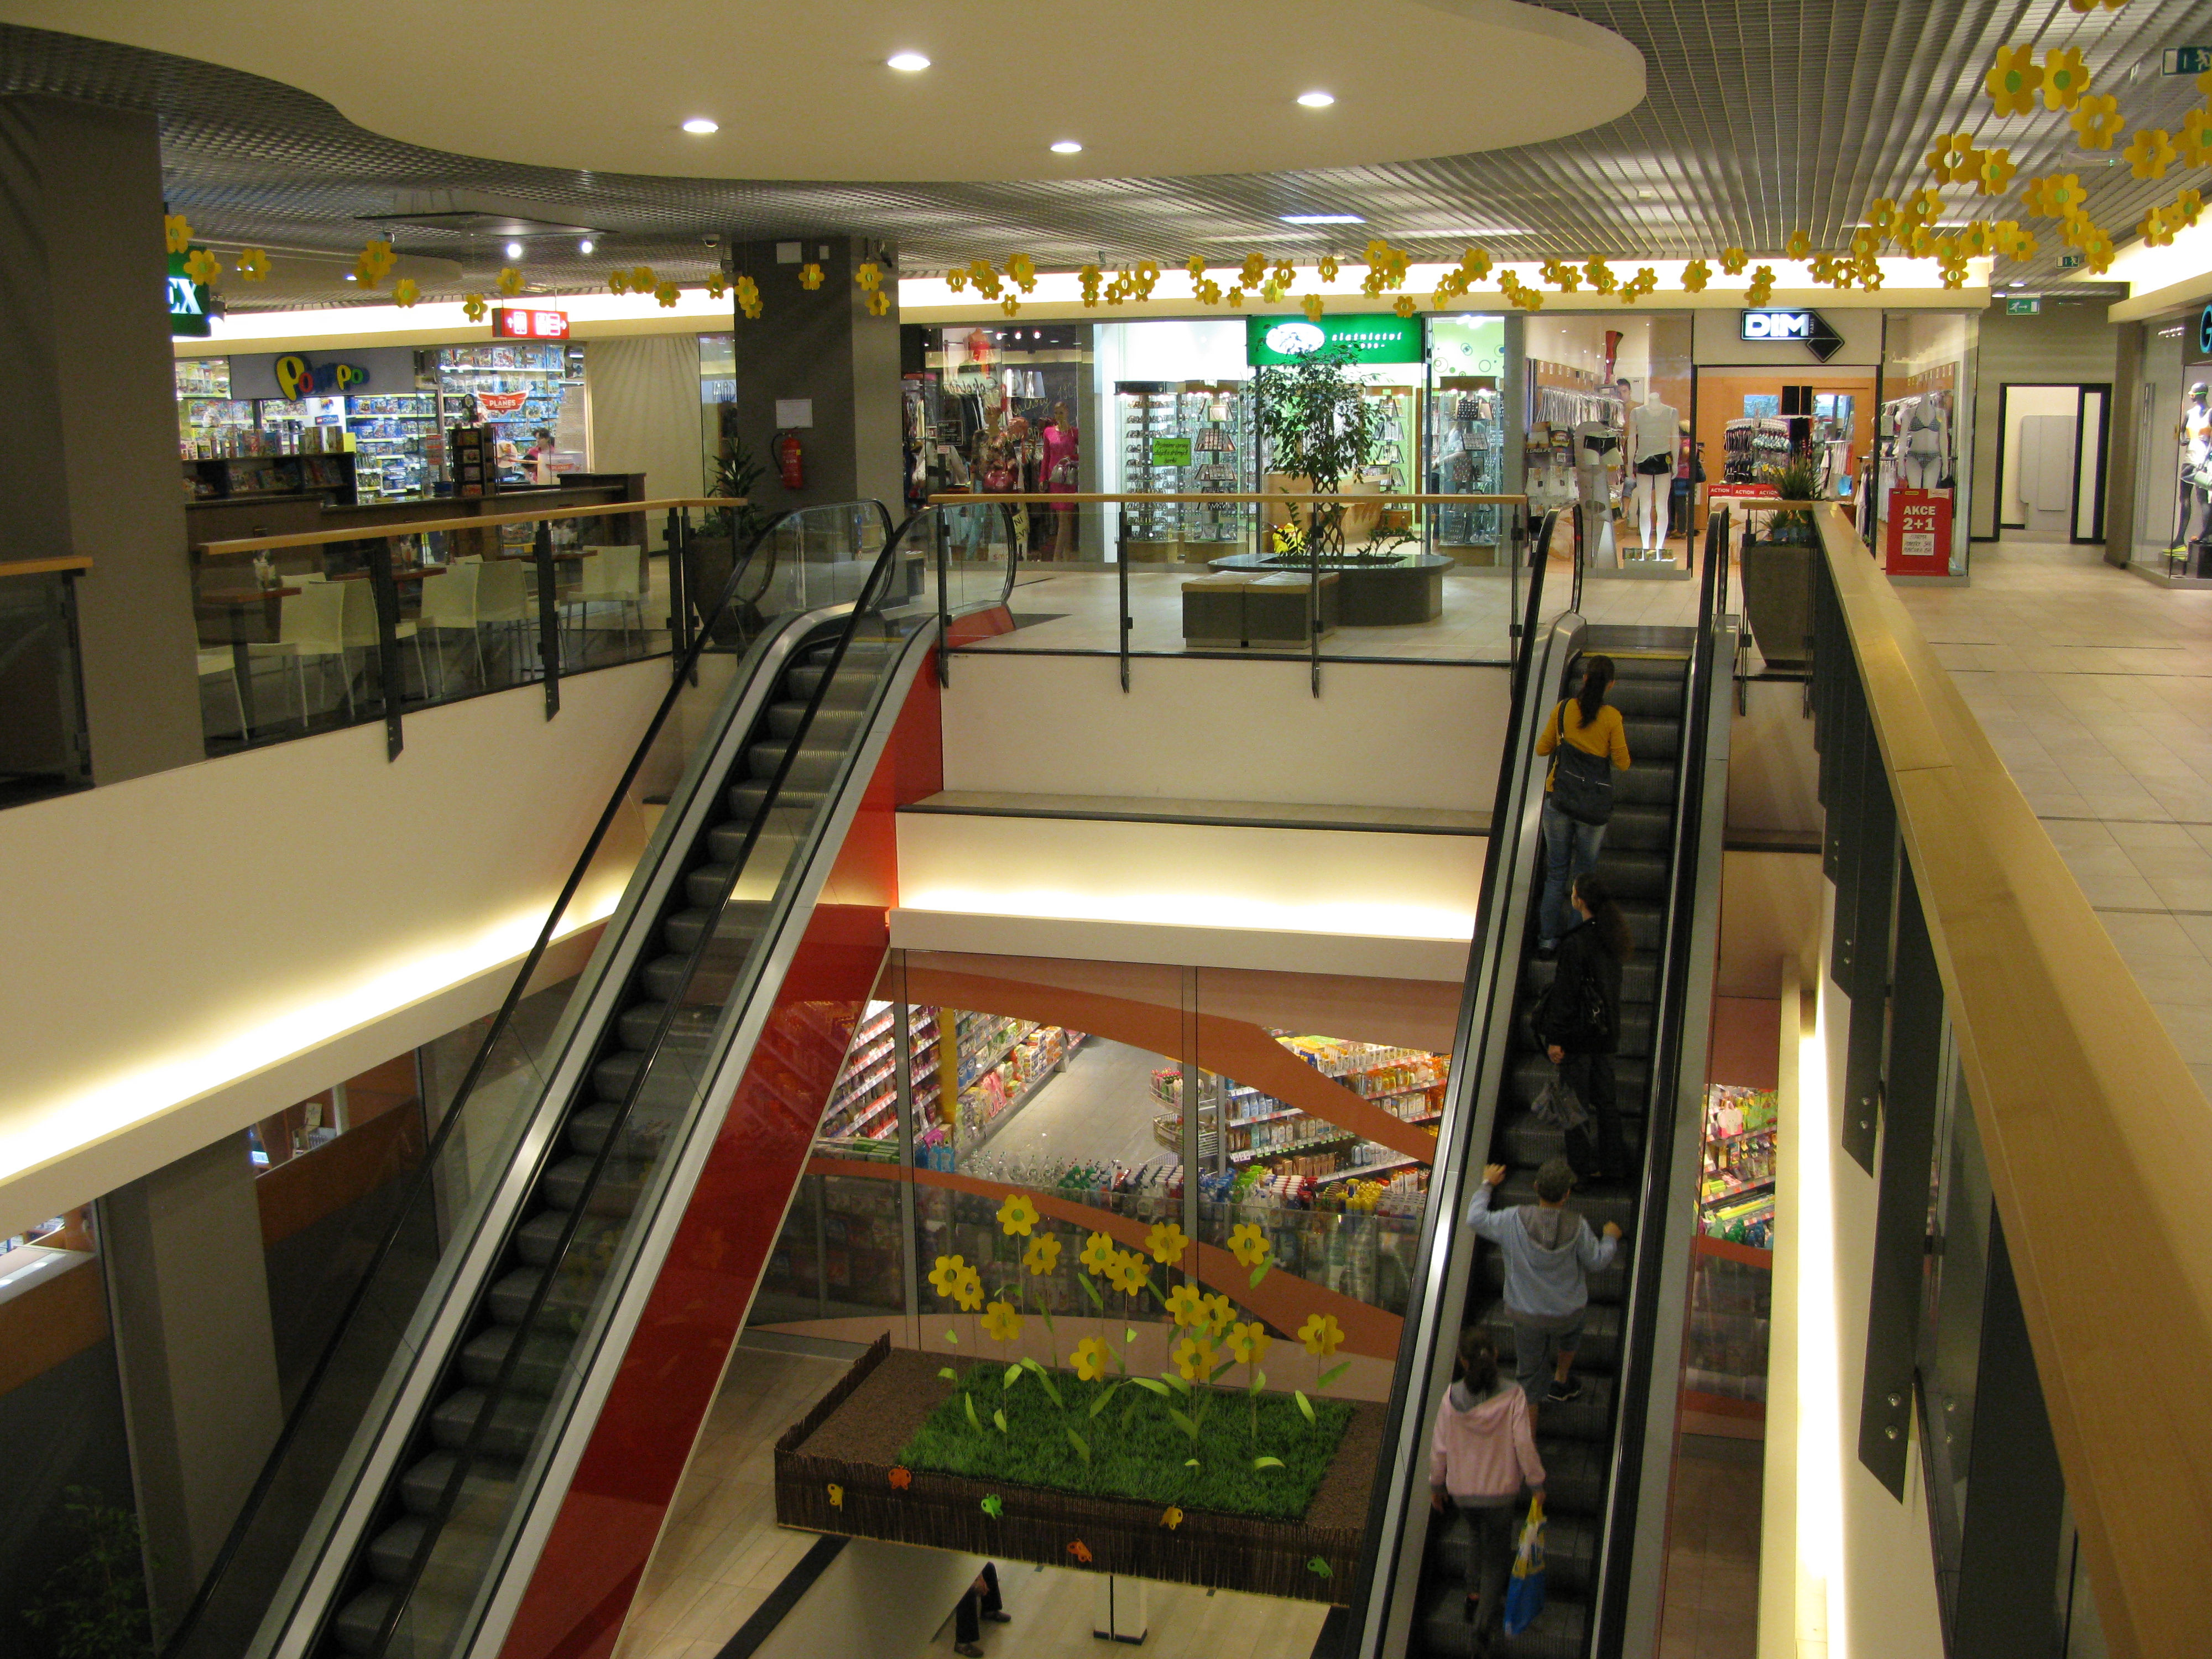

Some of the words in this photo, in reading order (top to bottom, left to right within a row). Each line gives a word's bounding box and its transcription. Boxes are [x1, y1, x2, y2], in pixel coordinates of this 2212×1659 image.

[1745, 314, 1809, 337] DIM
[1903, 505, 1936, 515] AKCE
[1902, 517, 1935, 531] 2+1
